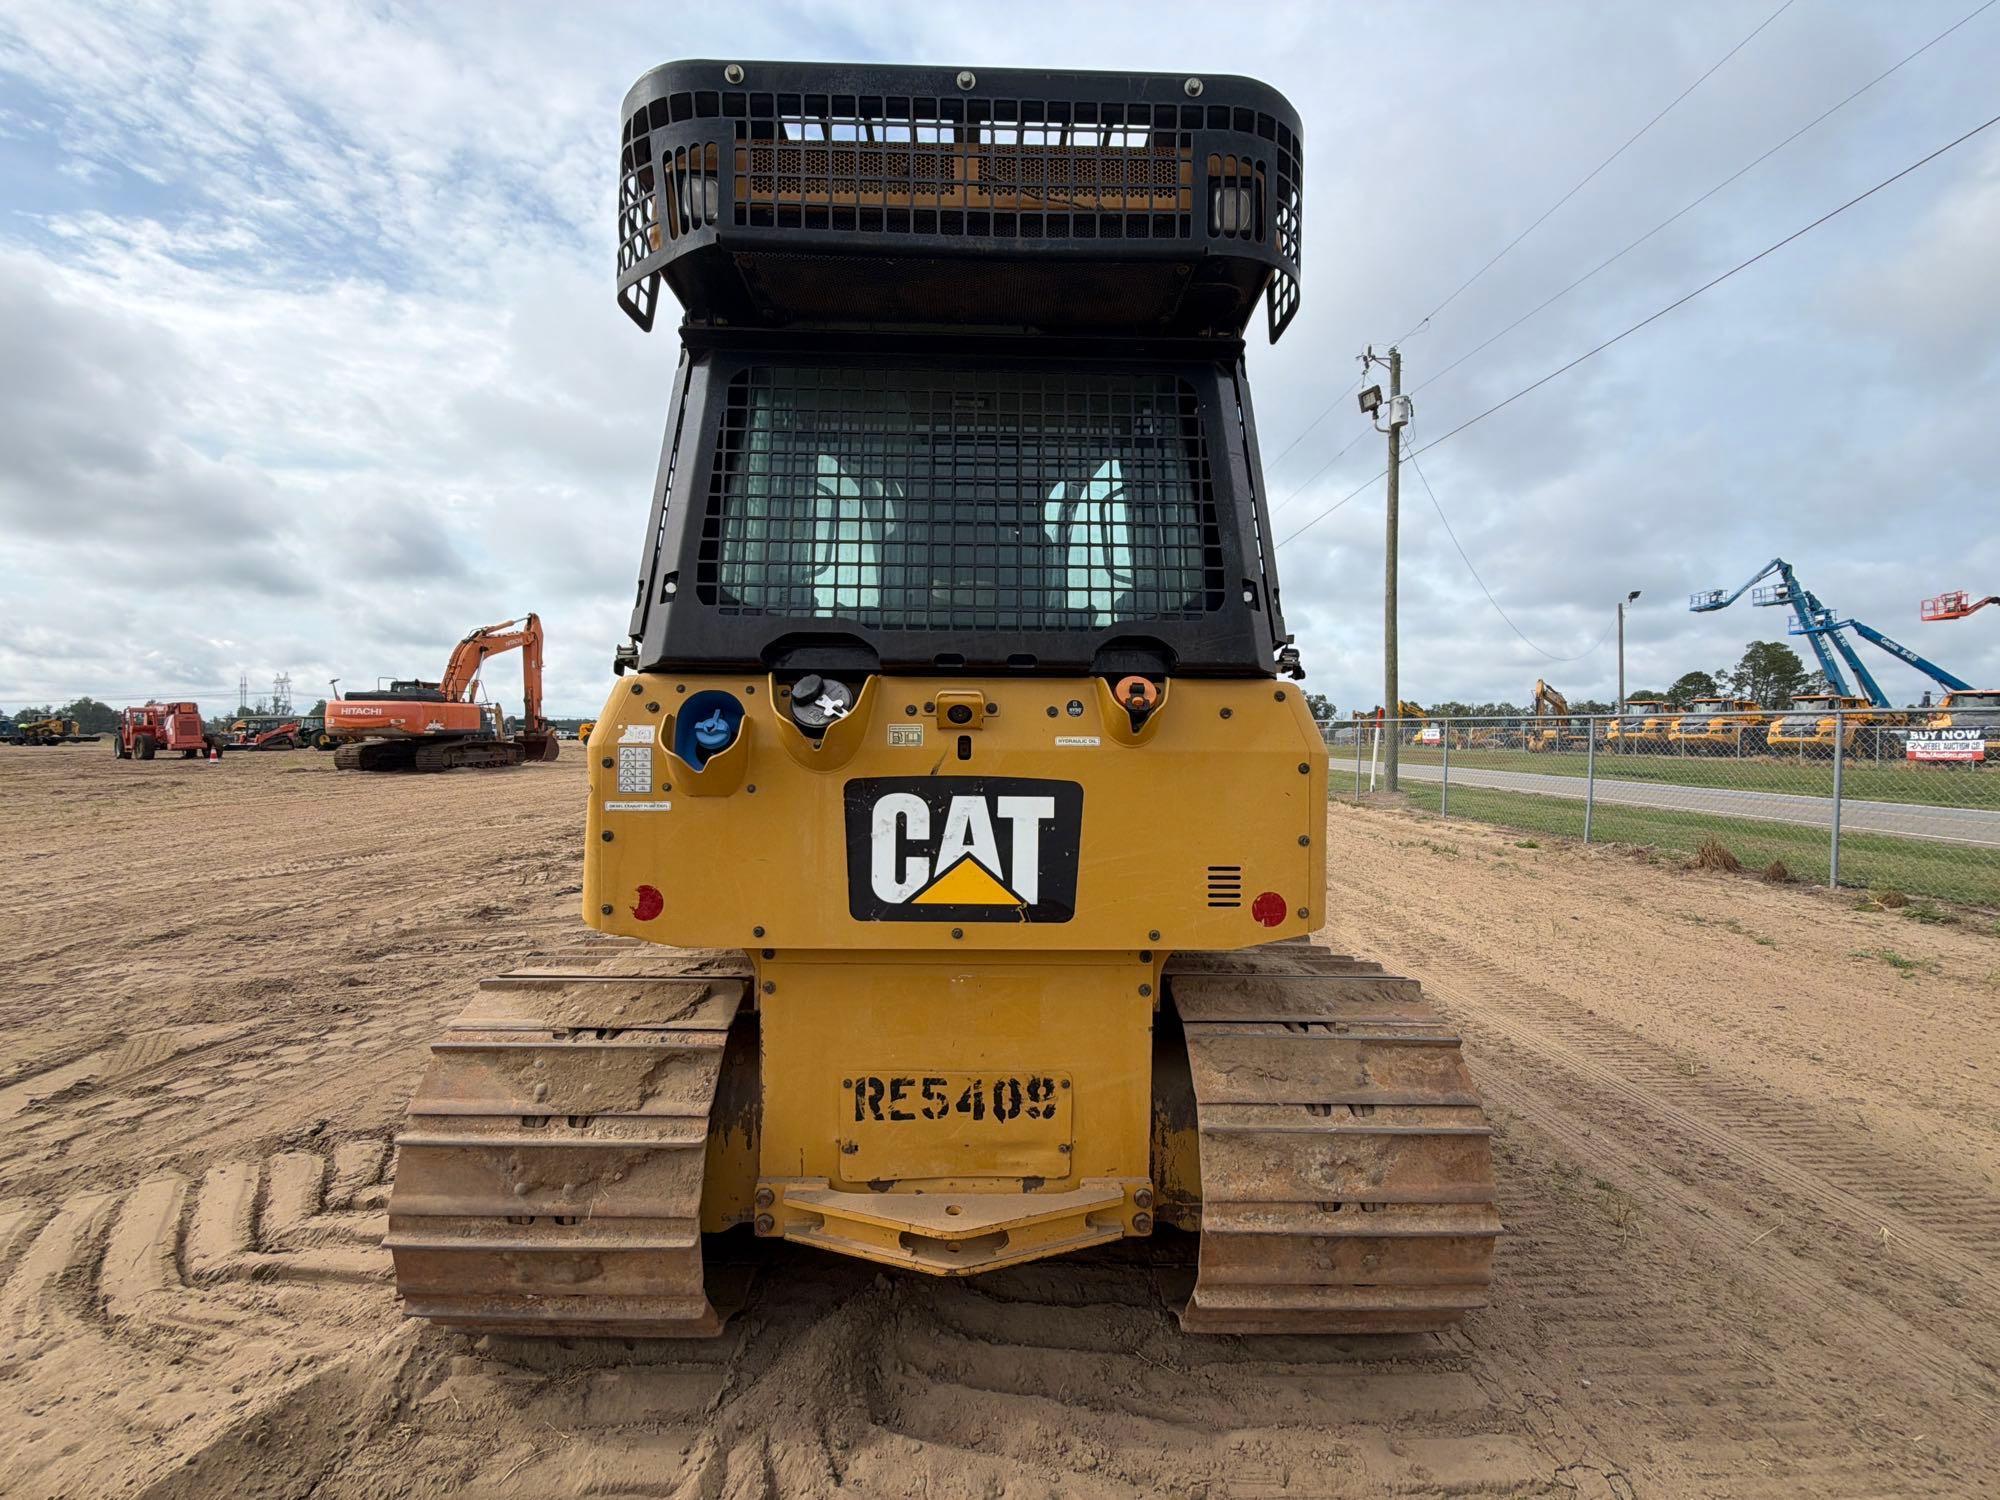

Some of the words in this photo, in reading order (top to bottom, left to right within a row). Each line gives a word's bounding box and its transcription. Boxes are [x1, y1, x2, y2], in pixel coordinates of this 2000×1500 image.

[341, 707, 382, 715] HITACHI
[1910, 730, 1938, 740] BUY
[1941, 730, 1981, 740] NOW
[871, 792, 1055, 905] CAT
